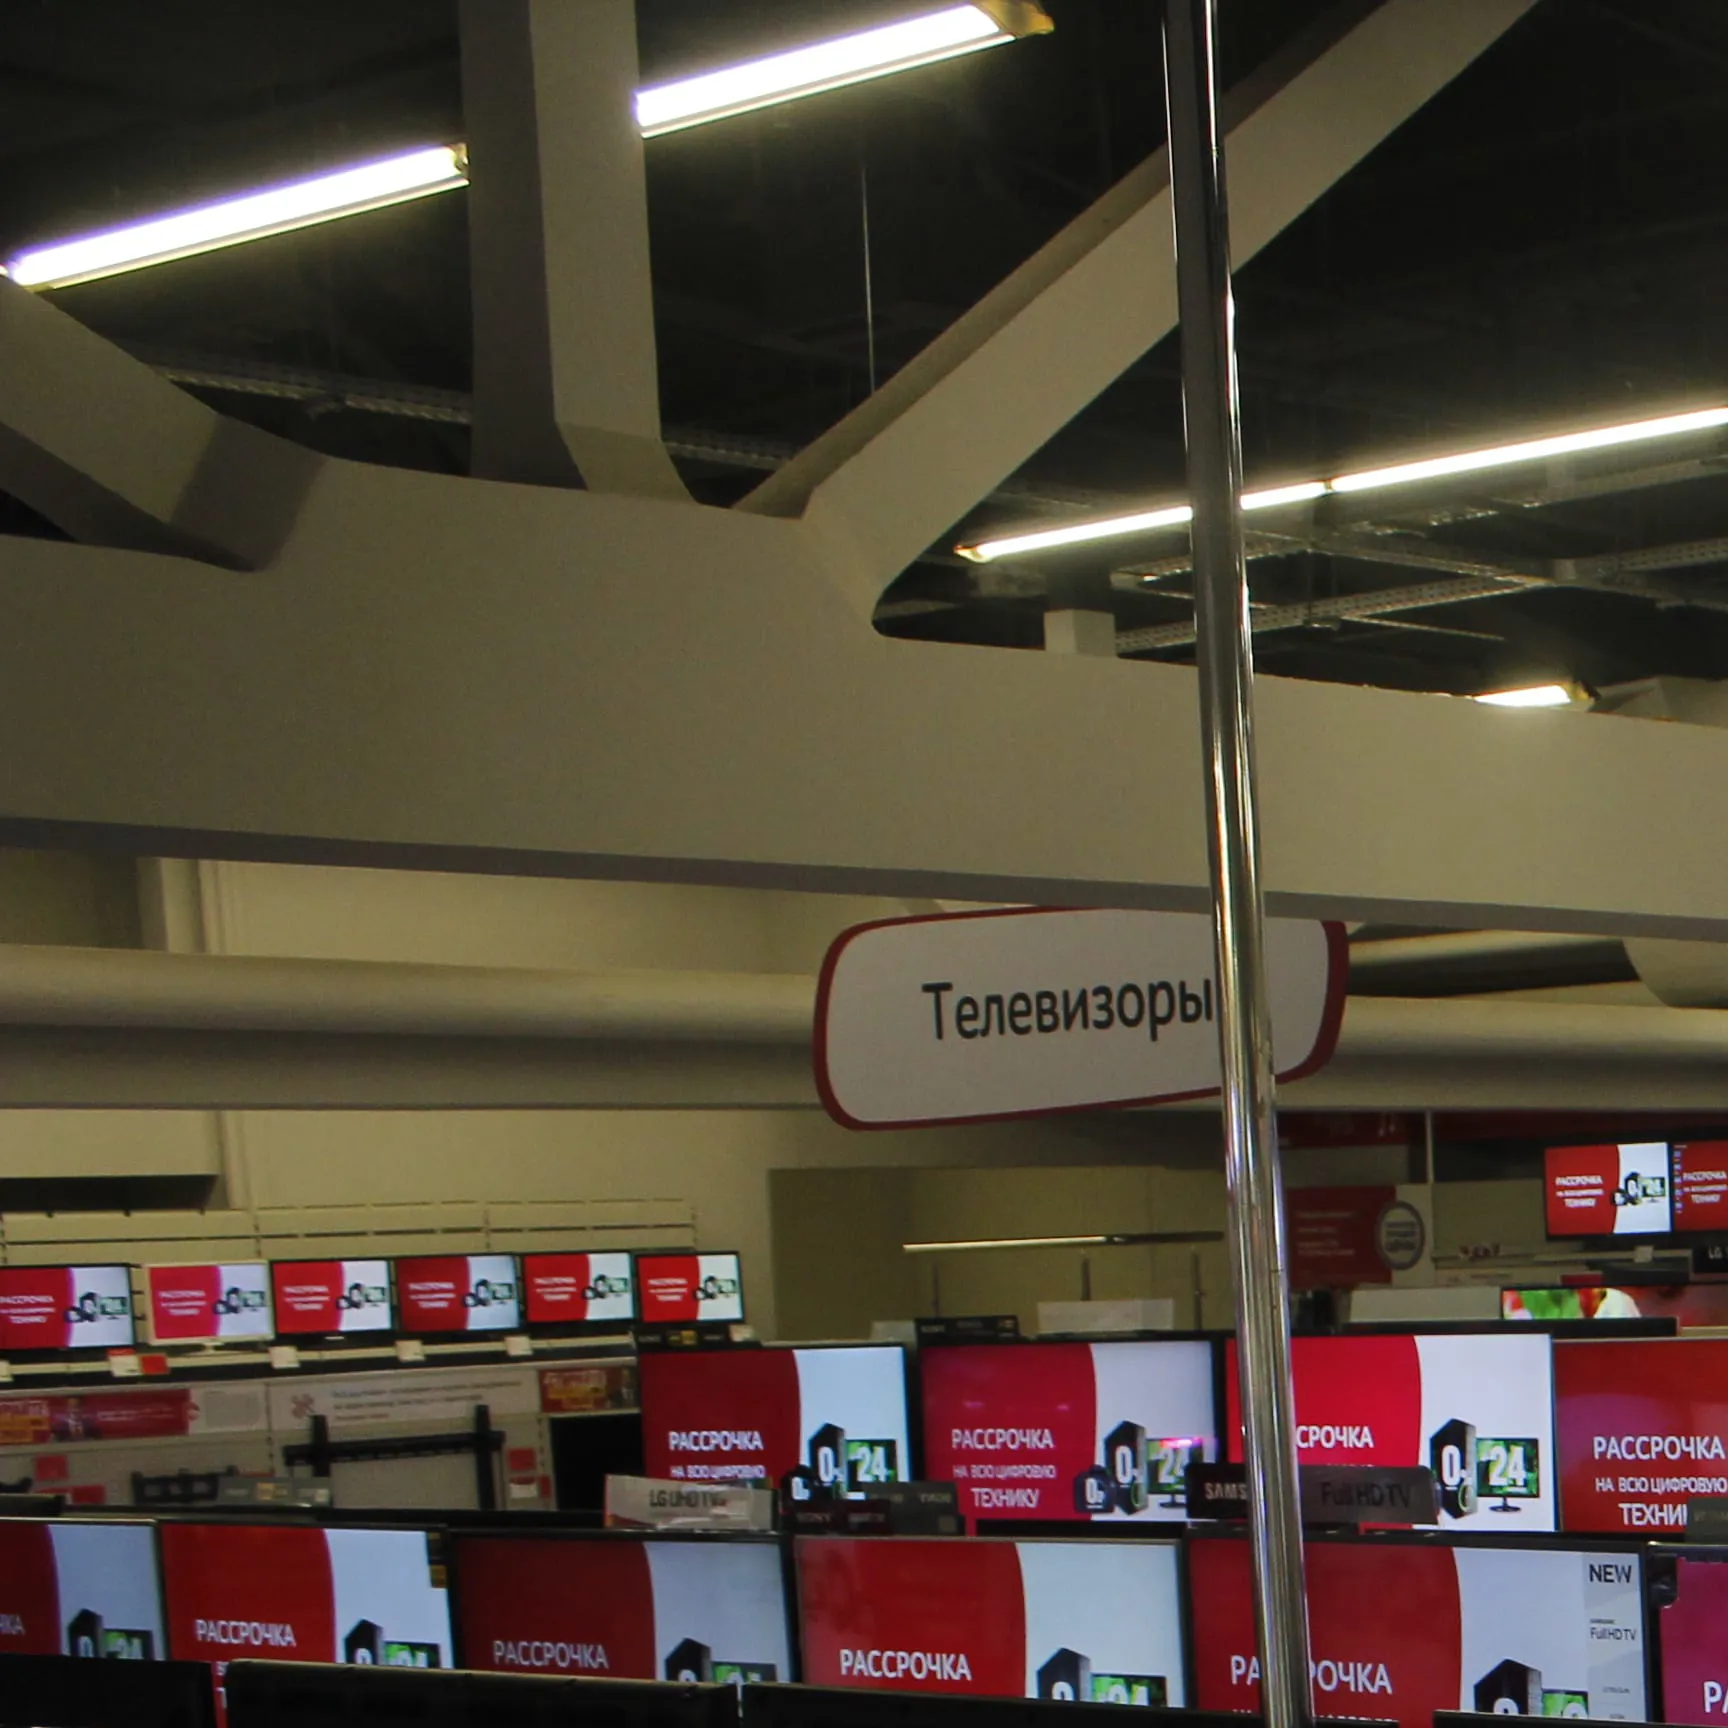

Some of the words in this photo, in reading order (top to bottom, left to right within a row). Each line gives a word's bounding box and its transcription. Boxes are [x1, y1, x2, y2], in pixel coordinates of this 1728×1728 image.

[922, 978, 1212, 1041] Телевизоры
[668, 1429, 764, 1452] РАССРОЧКА
[1594, 1435, 1726, 1461] РАССРОЧКА
[1588, 1563, 1632, 1583] NEW
[194, 1618, 297, 1647] РАССРОЧКА
[493, 1640, 609, 1670] РАССРОЧКА
[839, 1648, 972, 1683] РАССРОЧКА
